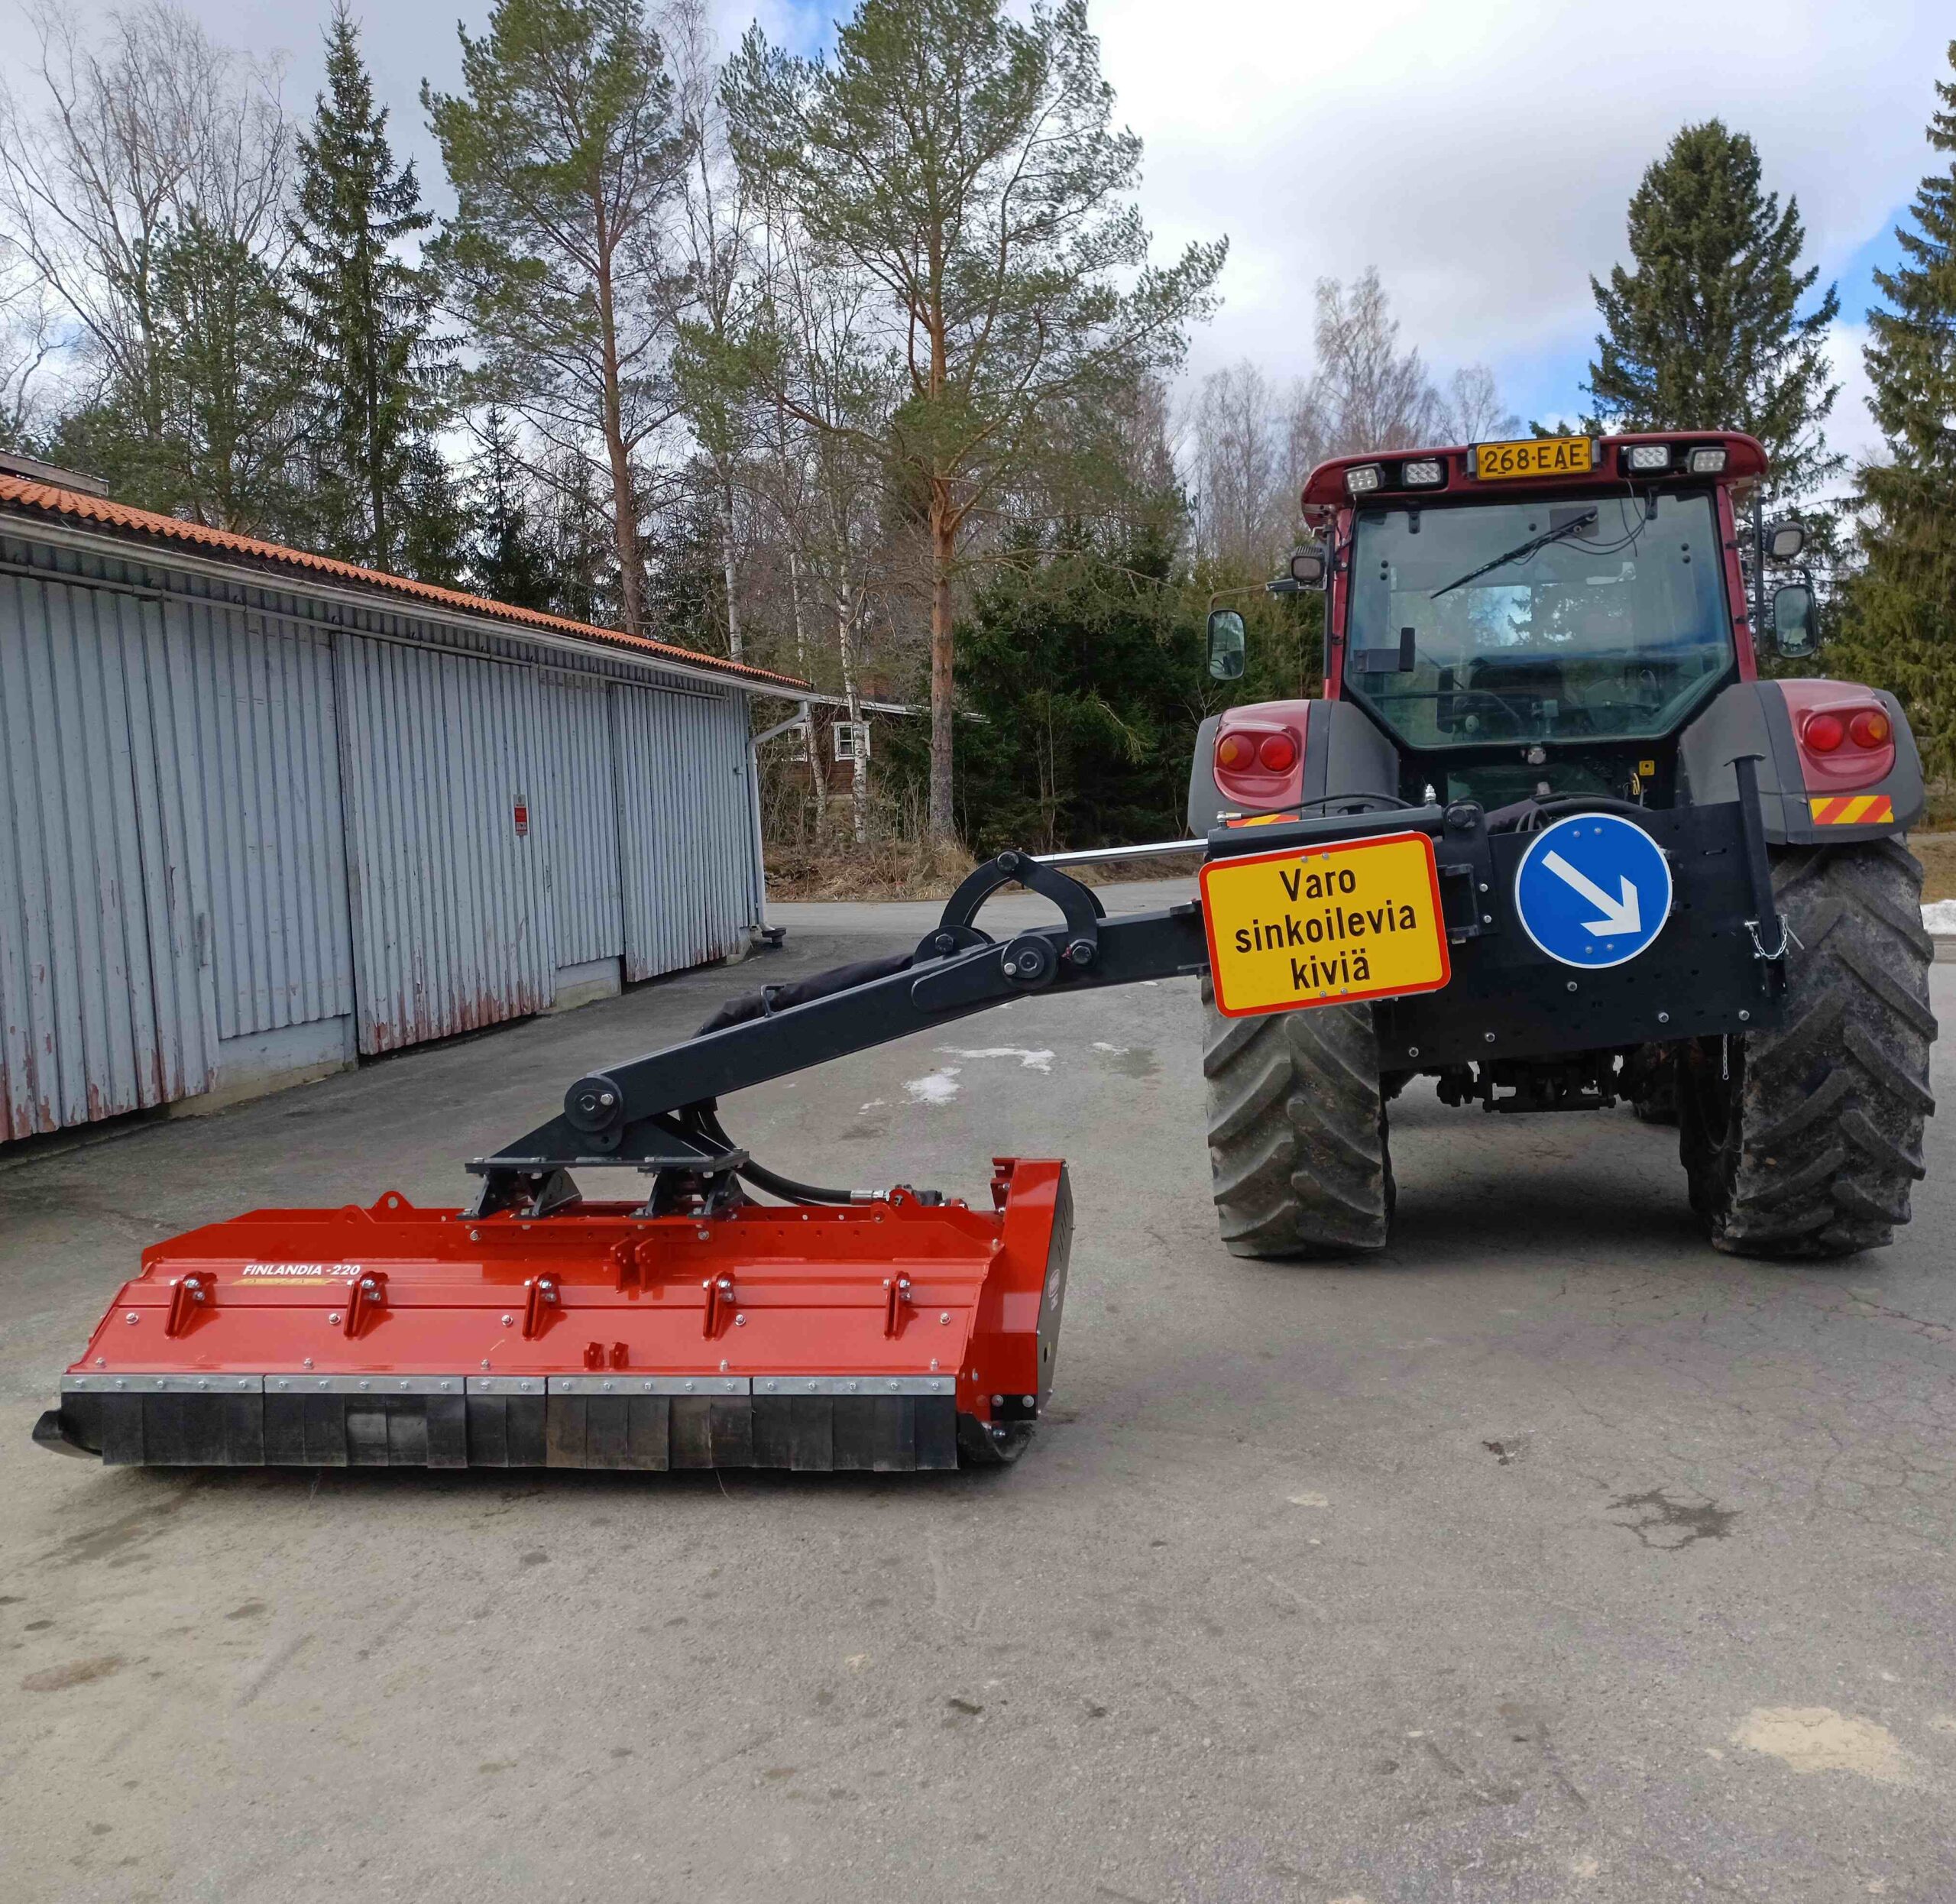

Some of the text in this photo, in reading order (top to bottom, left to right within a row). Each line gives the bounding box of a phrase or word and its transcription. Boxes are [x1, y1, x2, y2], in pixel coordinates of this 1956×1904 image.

[1279, 868, 1356, 902] Varo
[1235, 899, 1417, 954] sinkoilevia
[1291, 947, 1370, 990] kiviä
[242, 1264, 322, 1275] FINLANDIA
